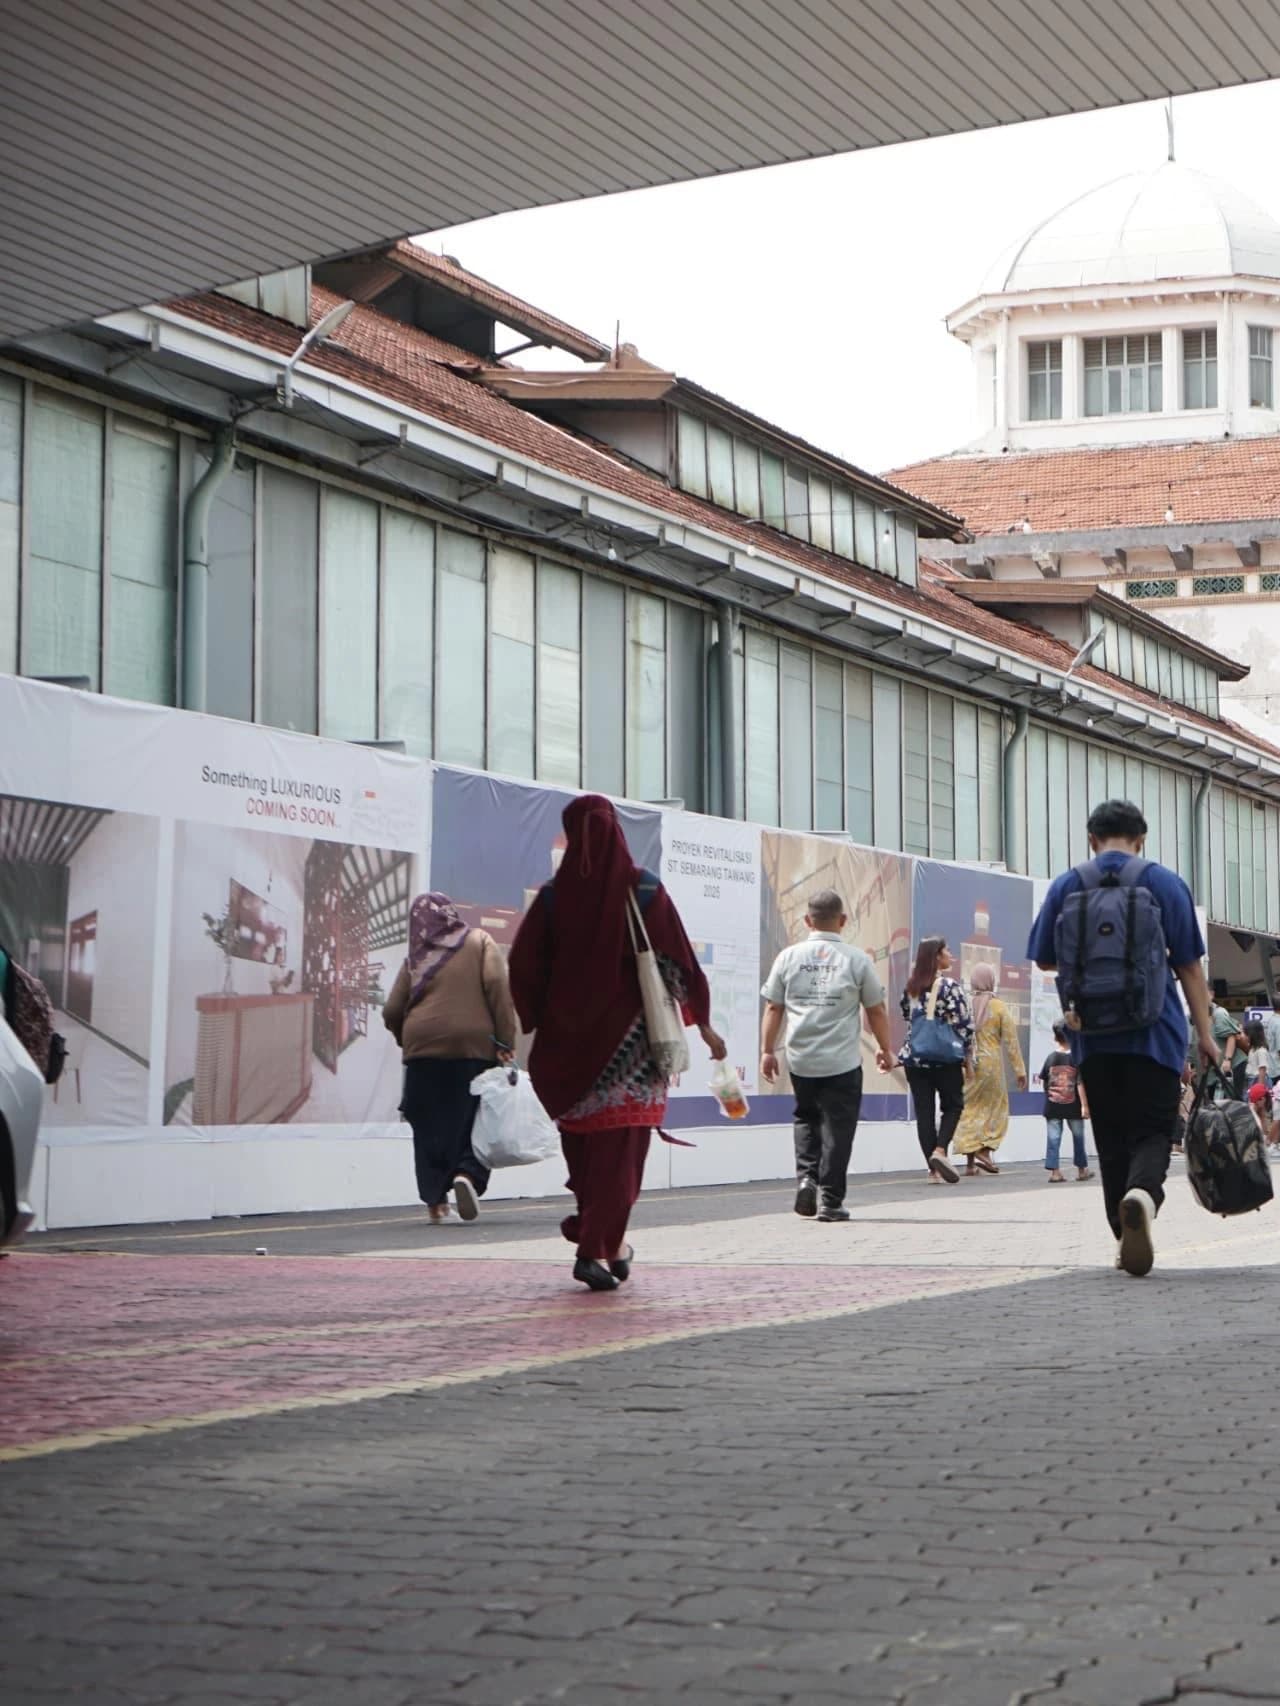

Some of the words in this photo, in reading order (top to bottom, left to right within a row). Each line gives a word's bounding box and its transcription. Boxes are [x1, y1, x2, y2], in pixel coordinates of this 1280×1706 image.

[201, 765, 267, 795] Something
[271, 777, 341, 804] LUXURIOUS
[246, 797, 298, 821] COMING
[672, 839, 702, 858] PROYEK
[703, 845, 752, 865] REVITALISASI
[680, 861, 722, 880] SEMARANG
[723, 867, 756, 885] TAWANG
